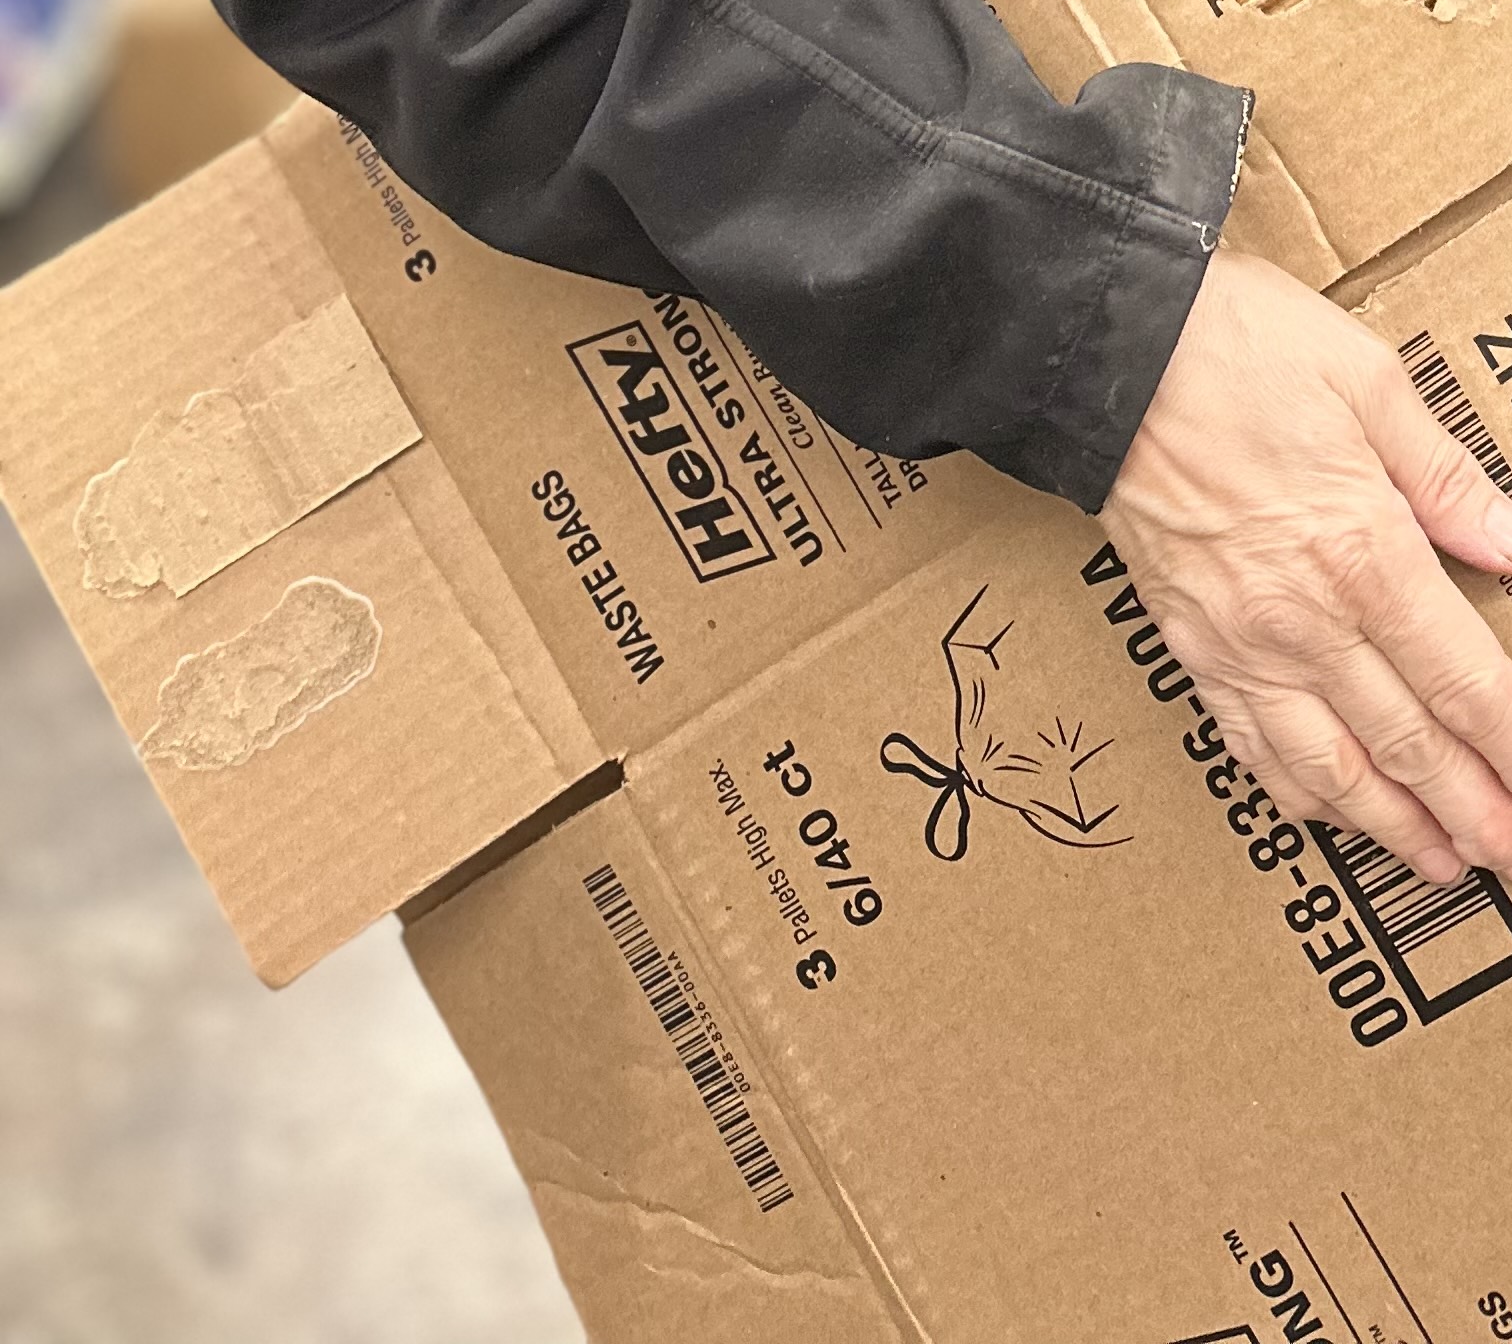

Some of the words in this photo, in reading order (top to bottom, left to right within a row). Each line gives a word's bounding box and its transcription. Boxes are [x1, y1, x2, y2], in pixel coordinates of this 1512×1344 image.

[336, 112, 362, 146] Ma
[356, 143, 386, 187] High
[382, 186, 421, 246] Pallets
[404, 247, 437, 283] 3
[770, 378, 813, 449] Clean
[740, 430, 823, 567] ULTRA
[865, 447, 902, 509] TALL
[532, 470, 602, 567] BAGS
[581, 560, 664, 685] WASTE
[709, 758, 745, 816] Max.
[763, 739, 812, 796] ct
[1080, 542, 1408, 1048] 00E8-8336-00AA
[737, 814, 775, 870] High
[799, 809, 882, 926] 6/40
[768, 869, 817, 945] Pallets
[796, 949, 836, 990] 3
[667, 950, 750, 1092] 00E8-8336-00AA
